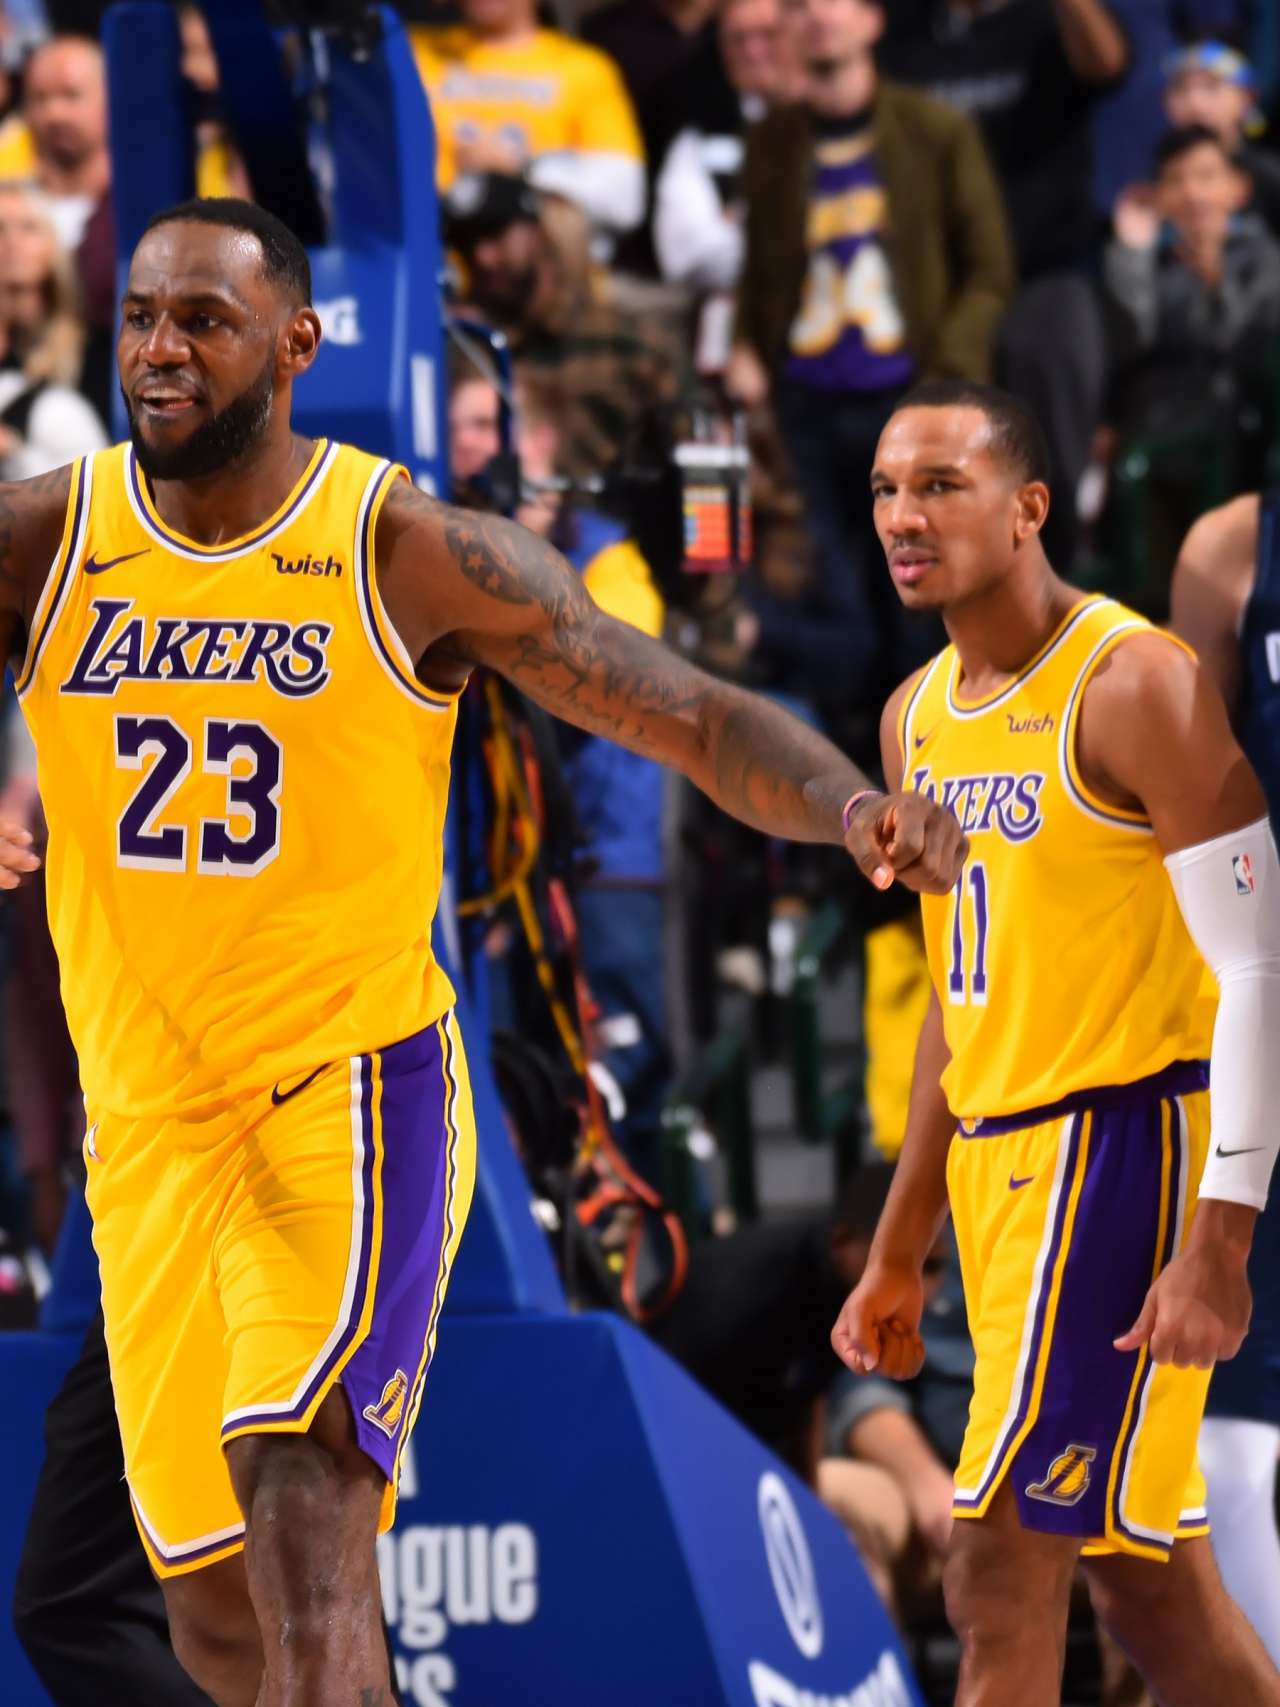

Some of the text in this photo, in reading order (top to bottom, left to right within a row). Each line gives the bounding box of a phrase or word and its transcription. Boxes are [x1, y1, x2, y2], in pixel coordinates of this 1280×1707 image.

[271, 552, 343, 578] wish
[59, 596, 334, 700] LAKERS
[1007, 712, 1054, 734] wish
[113, 712, 284, 878] 23
[947, 861, 990, 1006] 11
